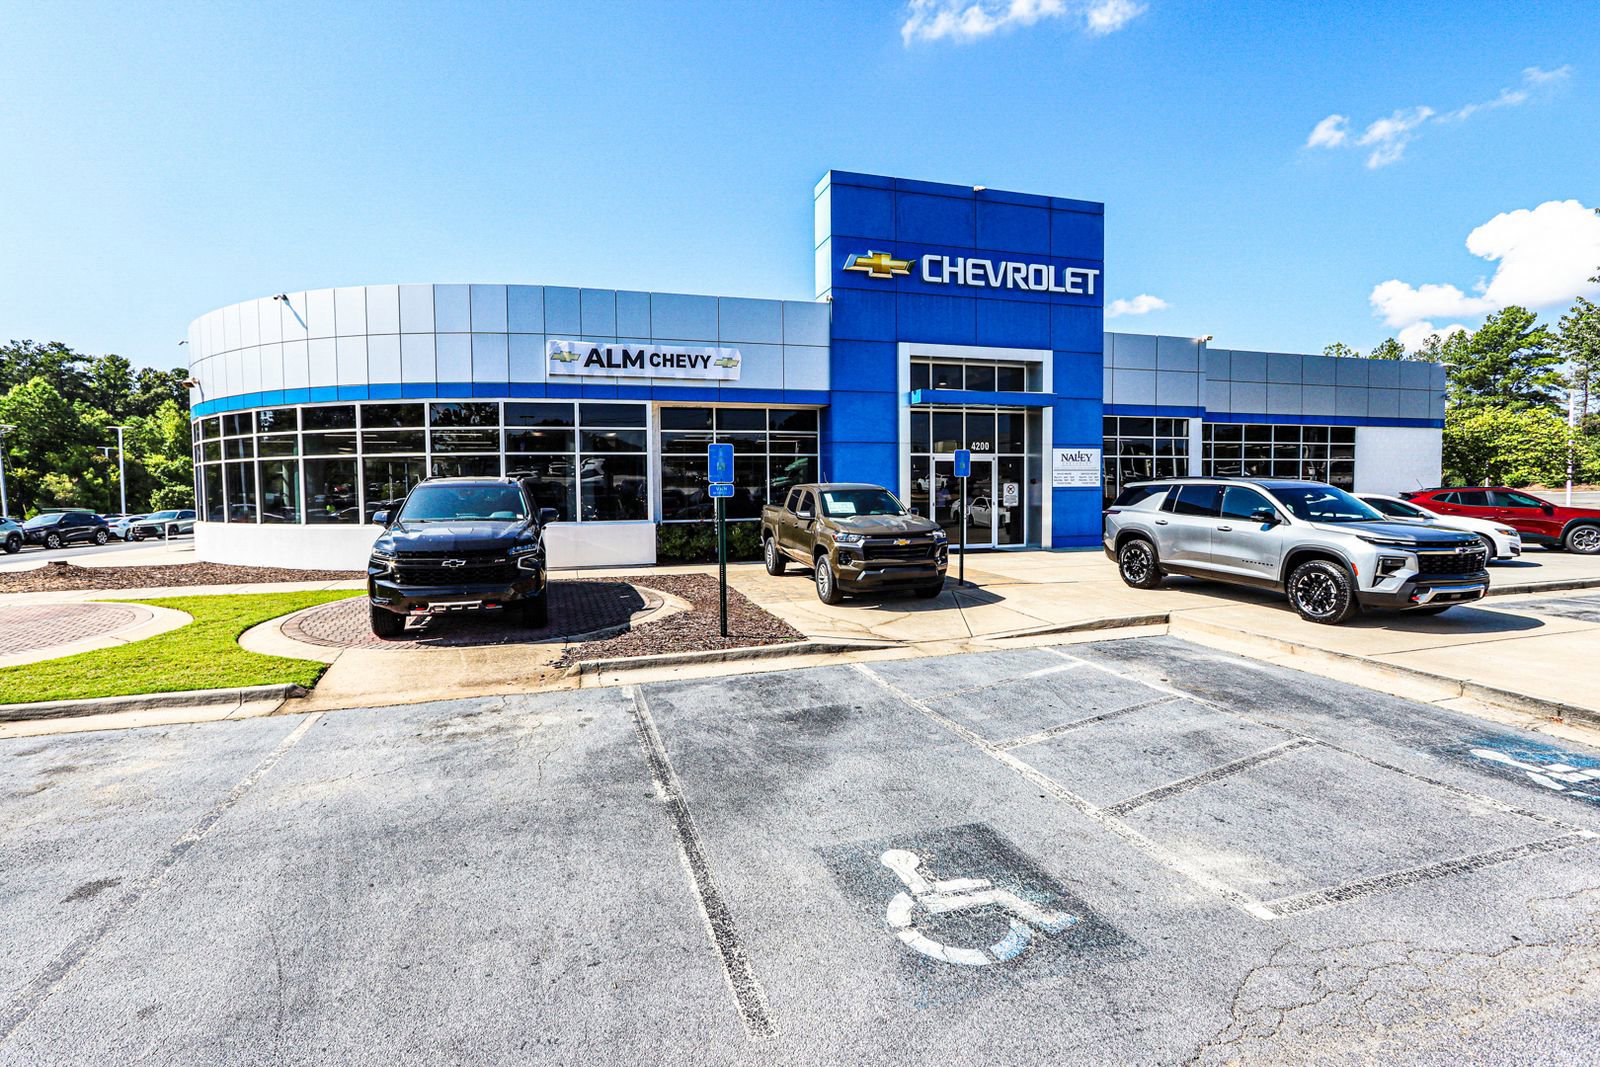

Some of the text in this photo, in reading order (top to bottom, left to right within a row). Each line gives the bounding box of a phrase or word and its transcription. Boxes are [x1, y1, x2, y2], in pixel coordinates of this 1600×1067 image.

[921, 254, 1100, 295] CHEVROLET
[584, 348, 711, 369] ALM CHEVY
[971, 442, 990, 451] 4200
